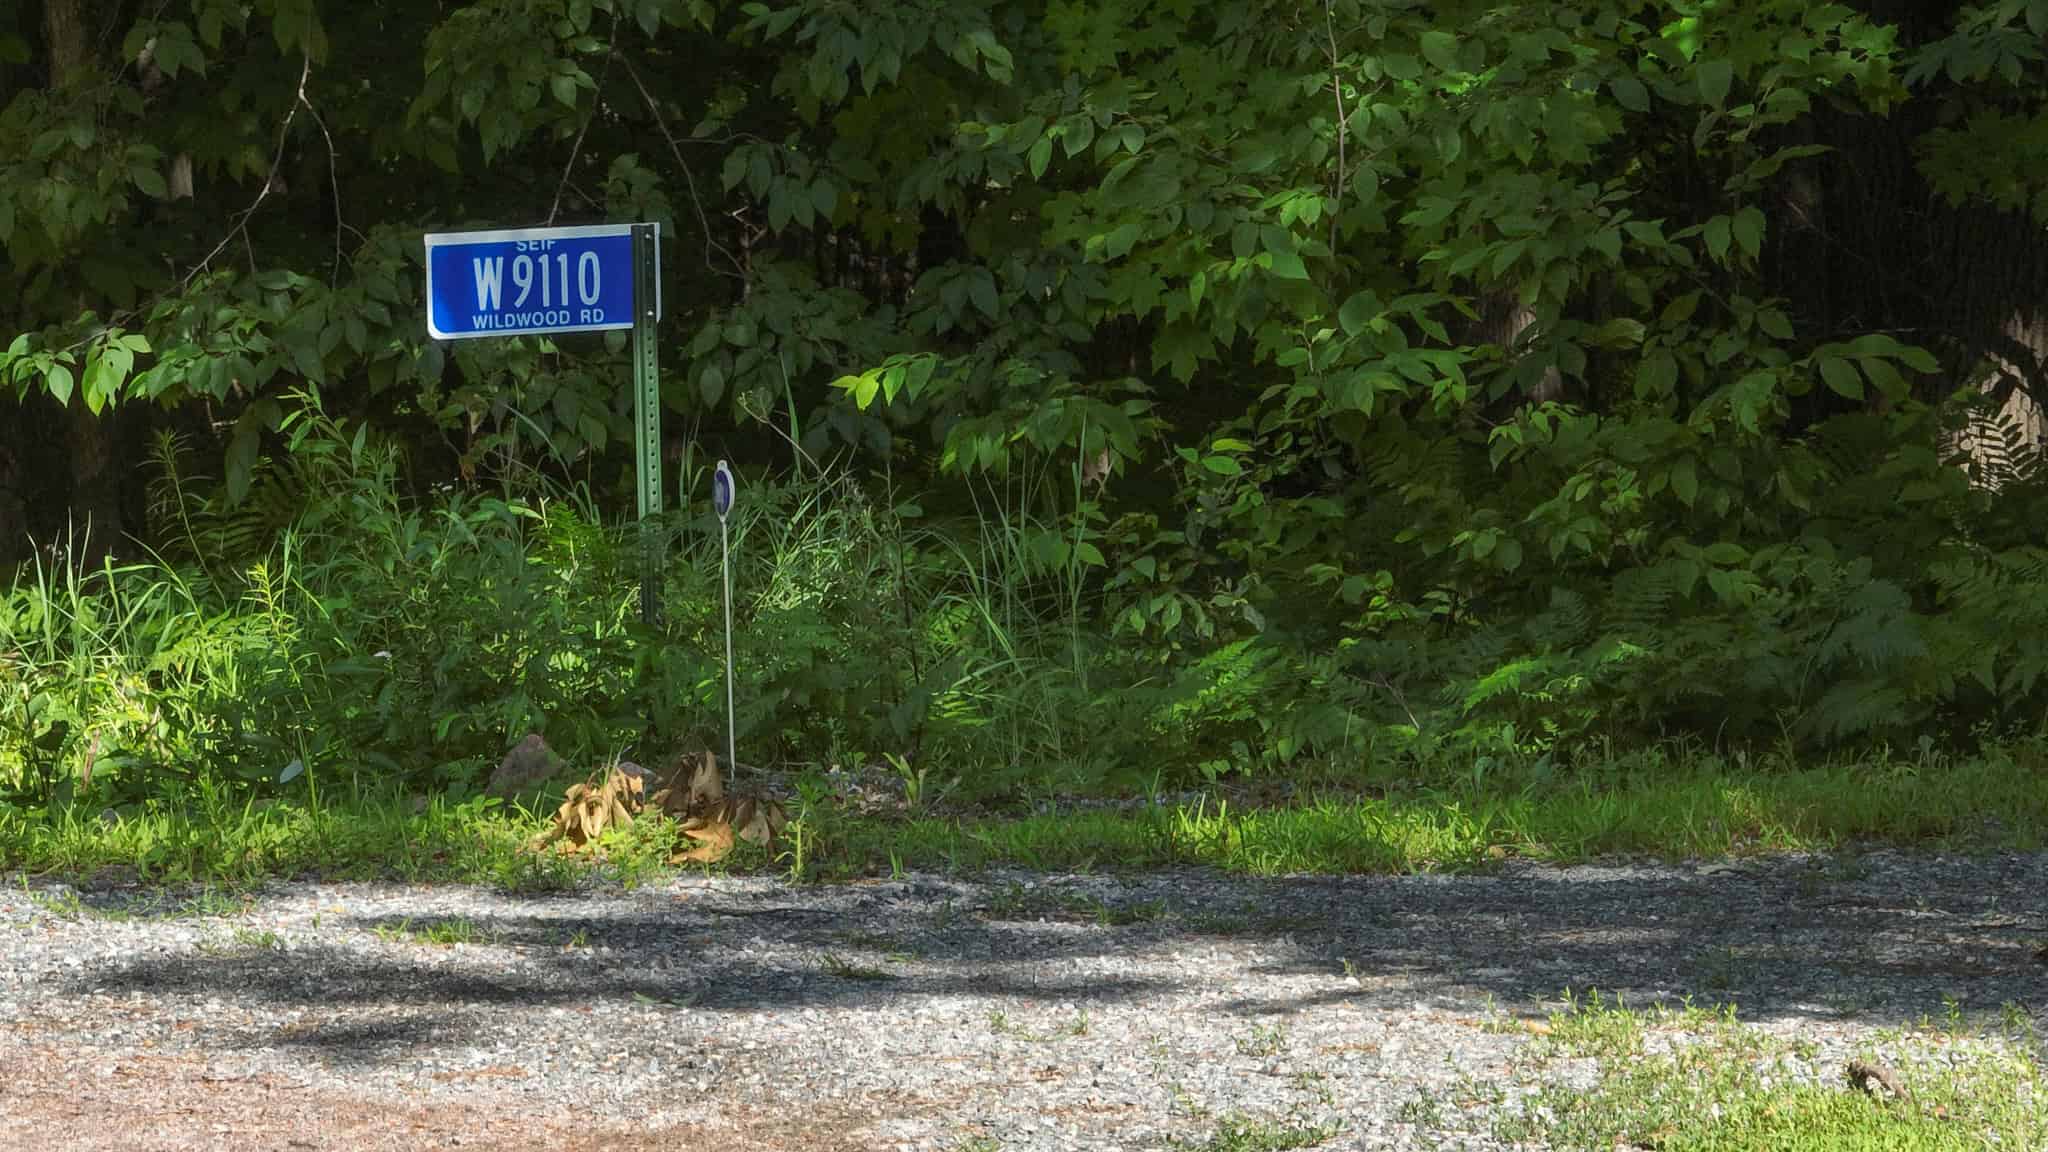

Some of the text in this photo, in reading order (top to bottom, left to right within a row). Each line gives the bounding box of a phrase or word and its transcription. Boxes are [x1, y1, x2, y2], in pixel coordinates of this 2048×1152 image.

[473, 251, 601, 311] W 9110
[473, 308, 605, 329] WILDWOOD RD
